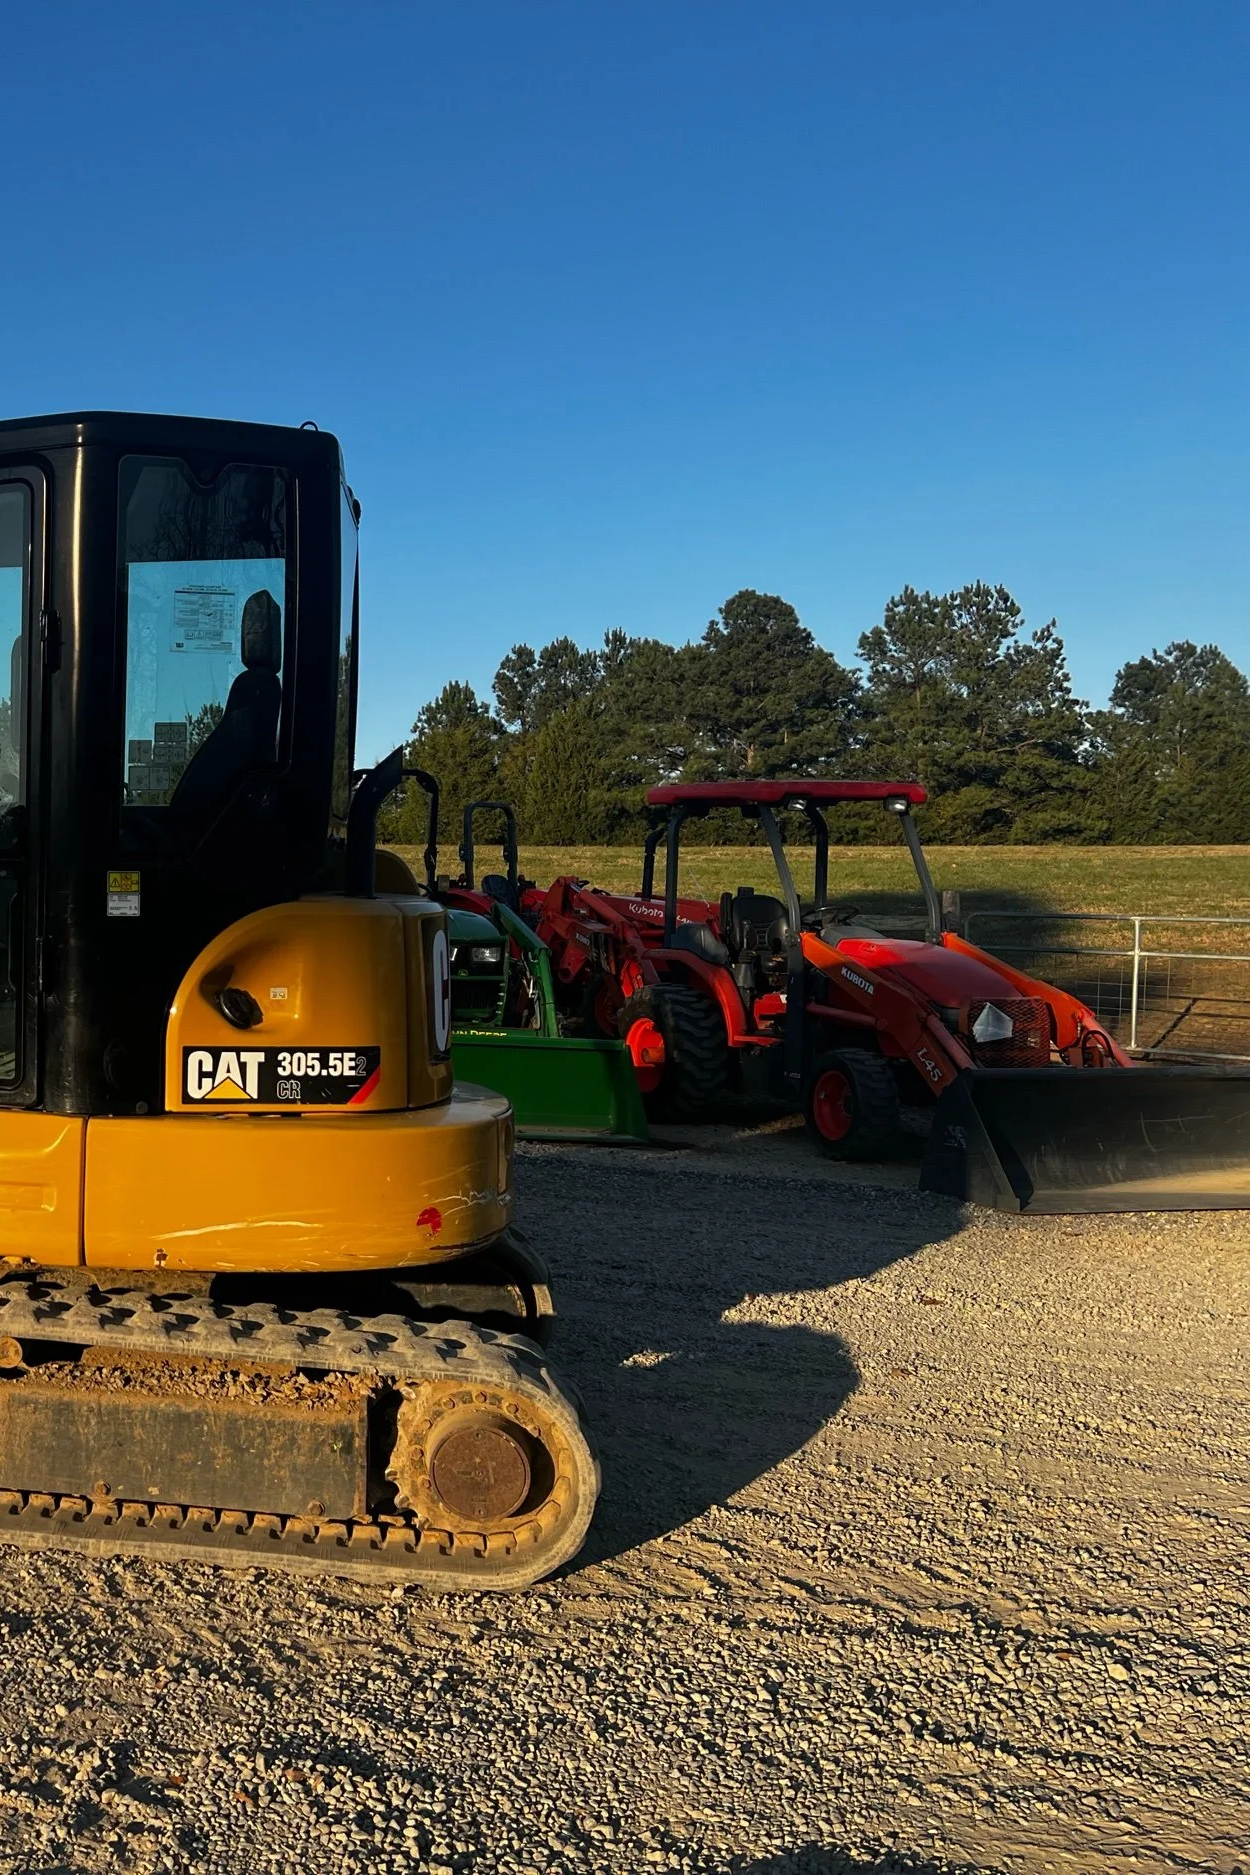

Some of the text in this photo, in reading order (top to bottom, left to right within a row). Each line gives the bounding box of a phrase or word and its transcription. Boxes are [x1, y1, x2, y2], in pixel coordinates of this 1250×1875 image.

[628, 902, 664, 918] Kubota
[840, 966, 874, 996] KUBOTA
[187, 1050, 367, 1099] CAT 305.5E2
[916, 1047, 943, 1082] L45
[276, 1080, 302, 1100] CR
